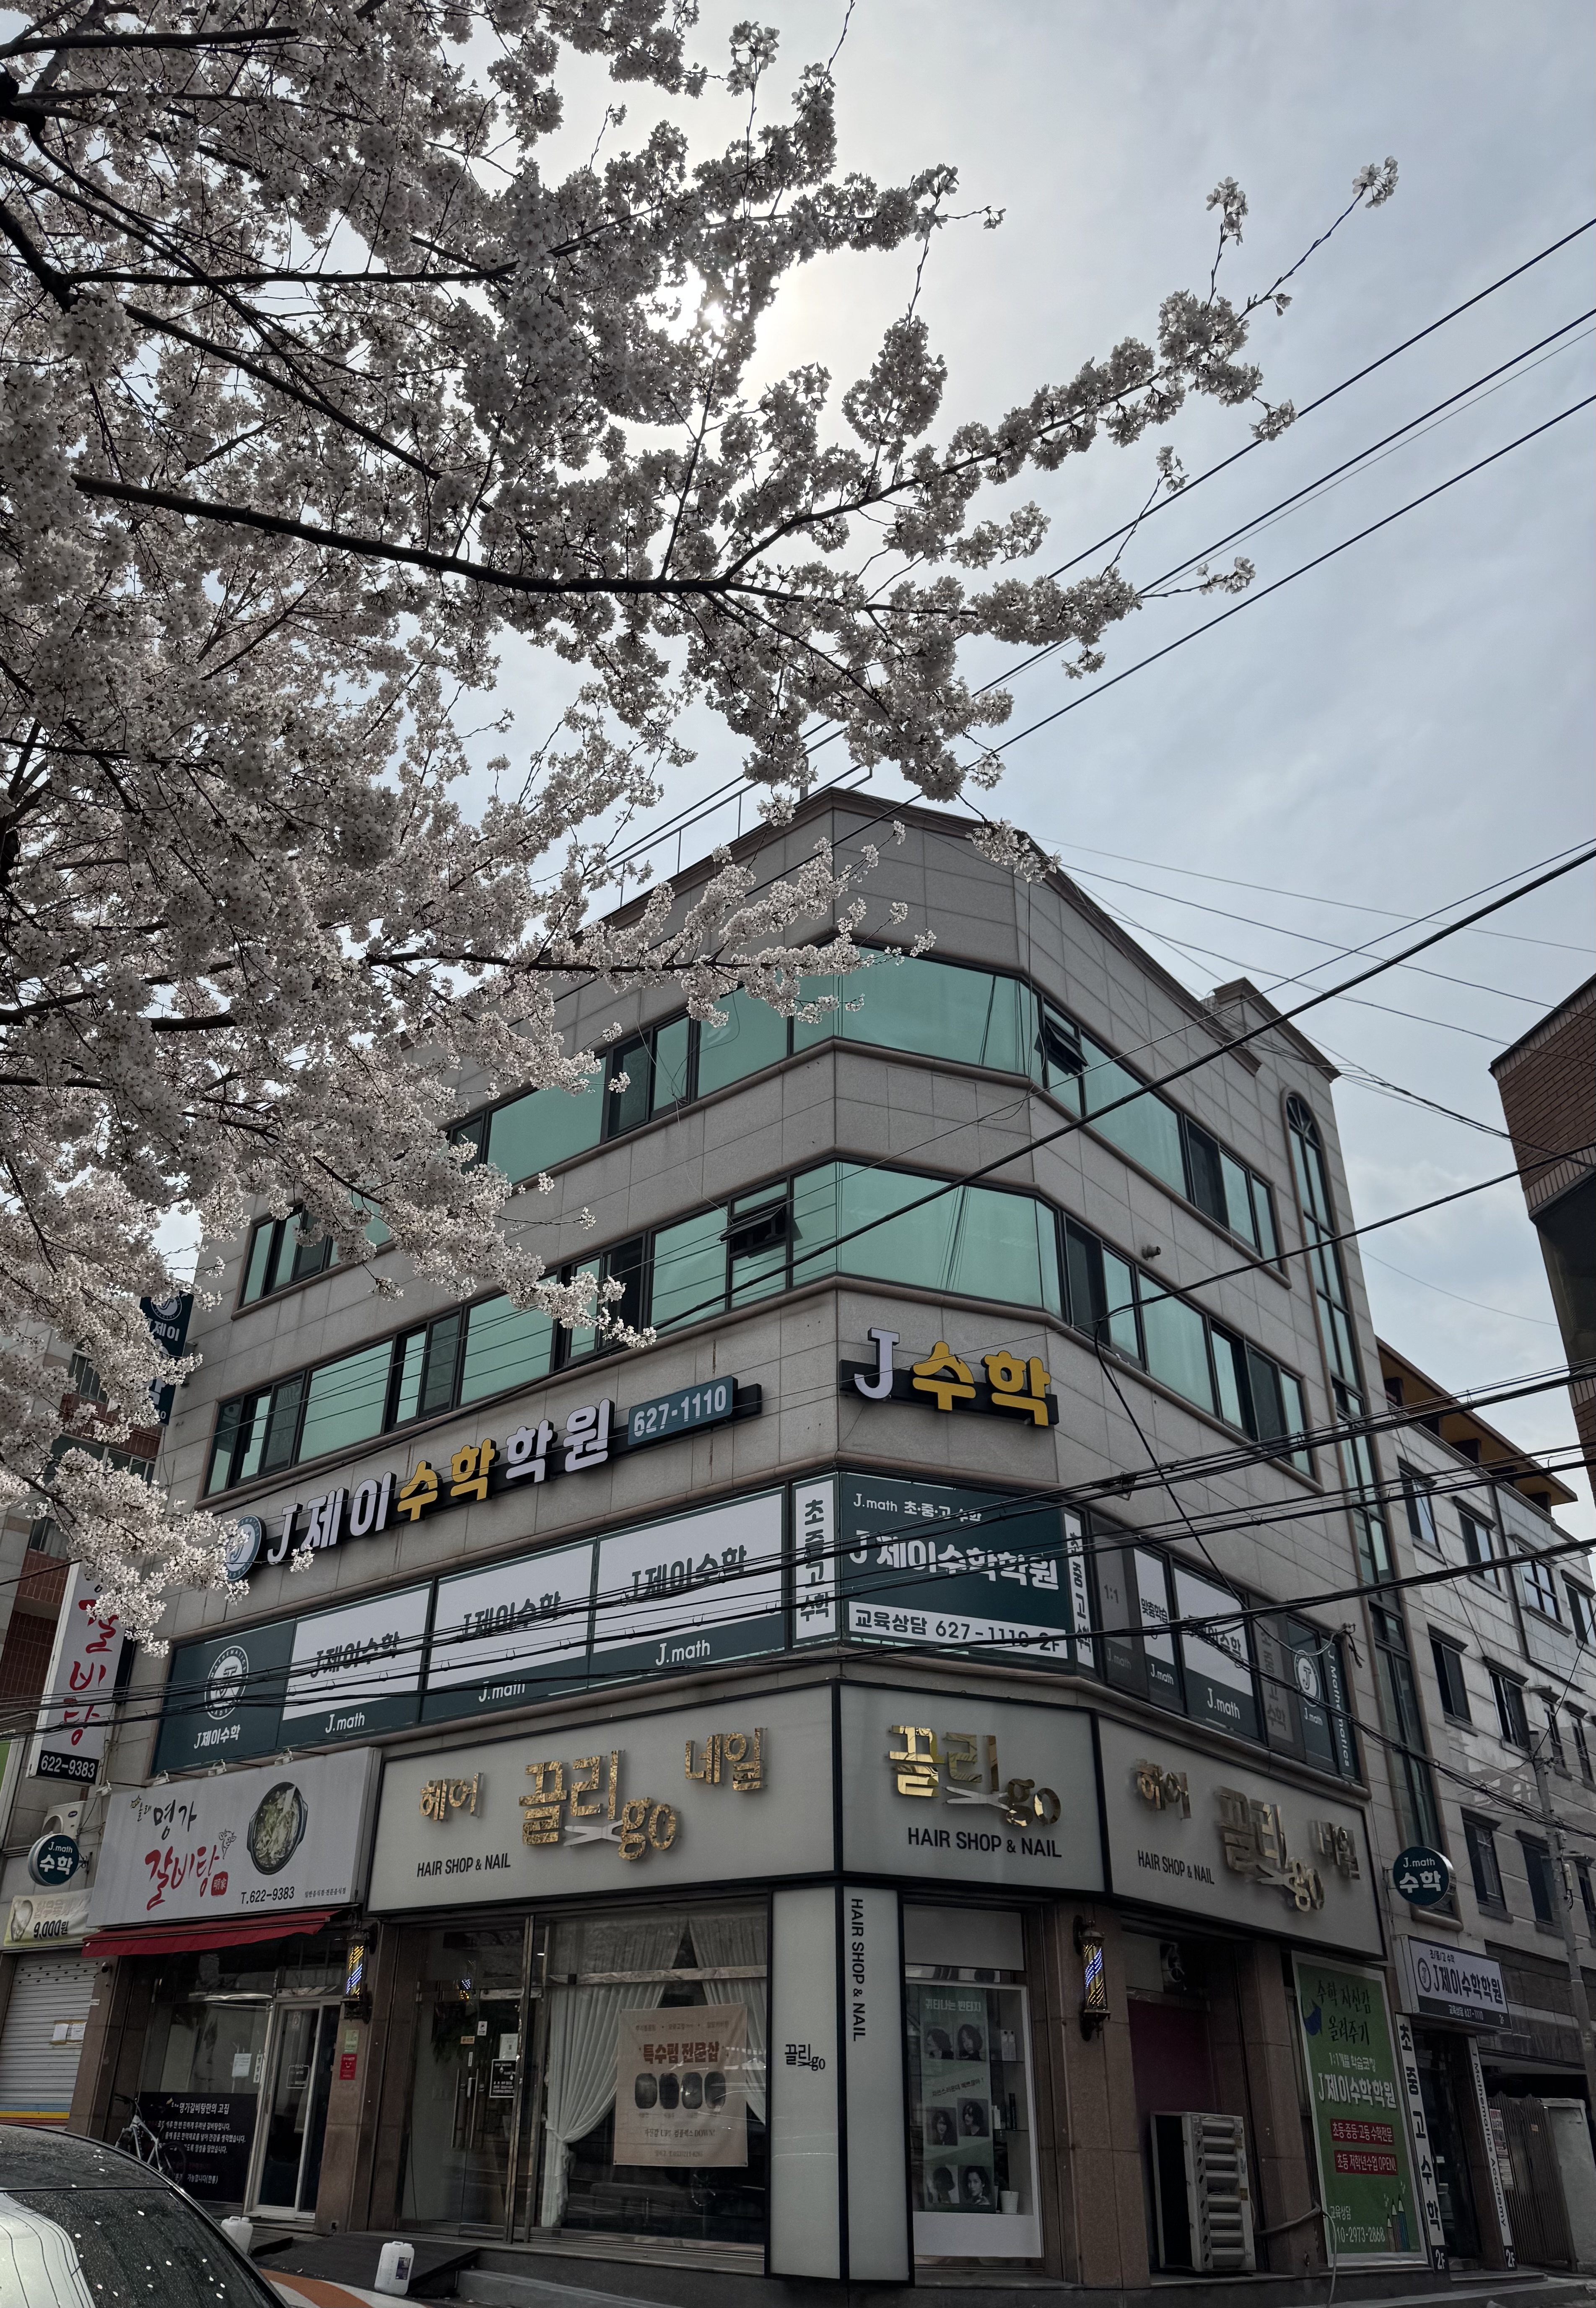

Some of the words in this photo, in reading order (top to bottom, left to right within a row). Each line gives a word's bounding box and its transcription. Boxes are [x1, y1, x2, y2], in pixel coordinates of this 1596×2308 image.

[634, 1385, 727, 1437] 627-1110
[854, 1493, 897, 1512] J.math
[856, 1609, 927, 1636] 교육상담
[656, 1640, 710, 1666] J.math
[1107, 1648, 1132, 1670] J.math
[1150, 1663, 1174, 1685] J.math
[1207, 1687, 1240, 1719] J.math
[325, 1712, 365, 1734] J.math
[41, 1755, 96, 1778] 622-9383
[420, 1772, 483, 1822] 헤어
[48, 1842, 73, 1853] J.math
[908, 1827, 950, 1848] HAIR
[956, 1831, 1002, 1851] SHOP
[1007, 1840, 1016, 1853] &
[1022, 1838, 1062, 1858] NAIL
[40, 1854, 73, 1875] 수학
[417, 1861, 442, 1877] HAIR
[445, 1856, 473, 1874] SHOP
[475, 1861, 482, 1871] &
[485, 1852, 511, 1870] NAIL
[1138, 1850, 1160, 1872] HAIR
[1162, 1856, 1185, 1877] SHOP
[1187, 1868, 1193, 1878] &
[1194, 1864, 1215, 1885] NAIL
[1403, 1857, 1435, 1867] J.math
[145, 1844, 220, 1911] 갈비탕
[1399, 1870, 1441, 1893] 수학
[241, 1886, 295, 1904] T.622-9383
[851, 1898, 864, 1937] HAIR
[851, 1942, 865, 1985] SHOP
[853, 1988, 863, 1997] &
[853, 2002, 866, 2041] NAIL
[643, 2043, 679, 2064] 특수펌
[1336, 2153, 1349, 2170] 초등
[1332, 2227, 1386, 2243] 10-2973-2868
[1435, 2248, 1445, 2270] 2F
[1506, 2248, 1516, 2268] 2F
